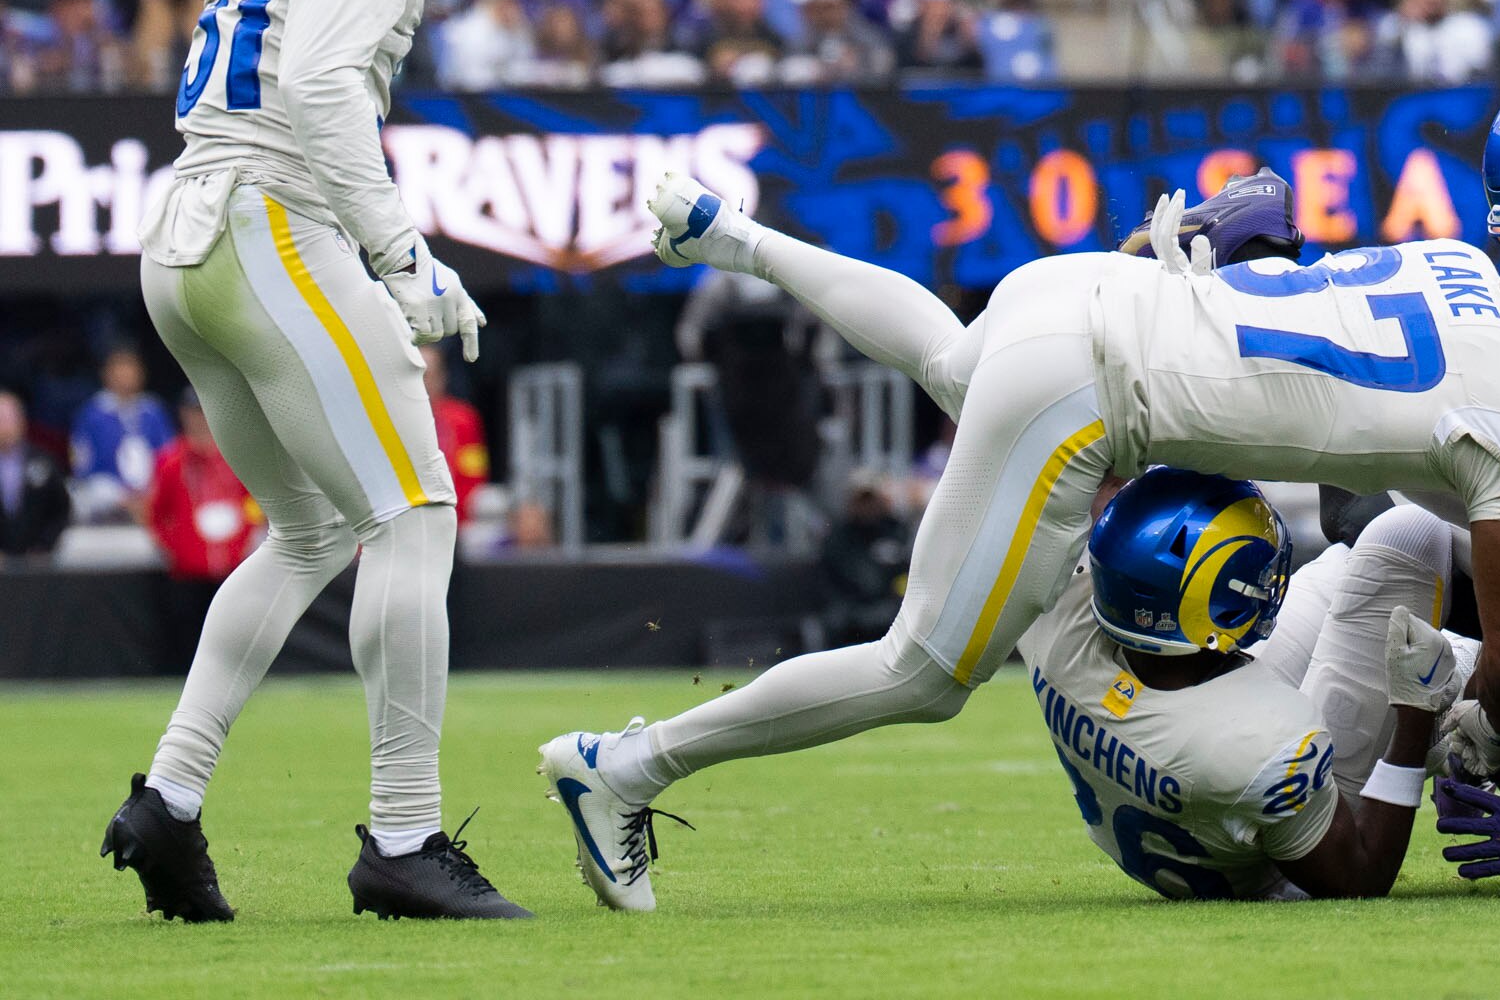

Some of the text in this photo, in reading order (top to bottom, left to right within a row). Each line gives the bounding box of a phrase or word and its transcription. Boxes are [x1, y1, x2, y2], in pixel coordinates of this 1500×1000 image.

[0, 131, 173, 255] Pri
[382, 122, 764, 255] RAVENS
[930, 149, 1098, 247] 30
[1263, 742, 1336, 815] 26
